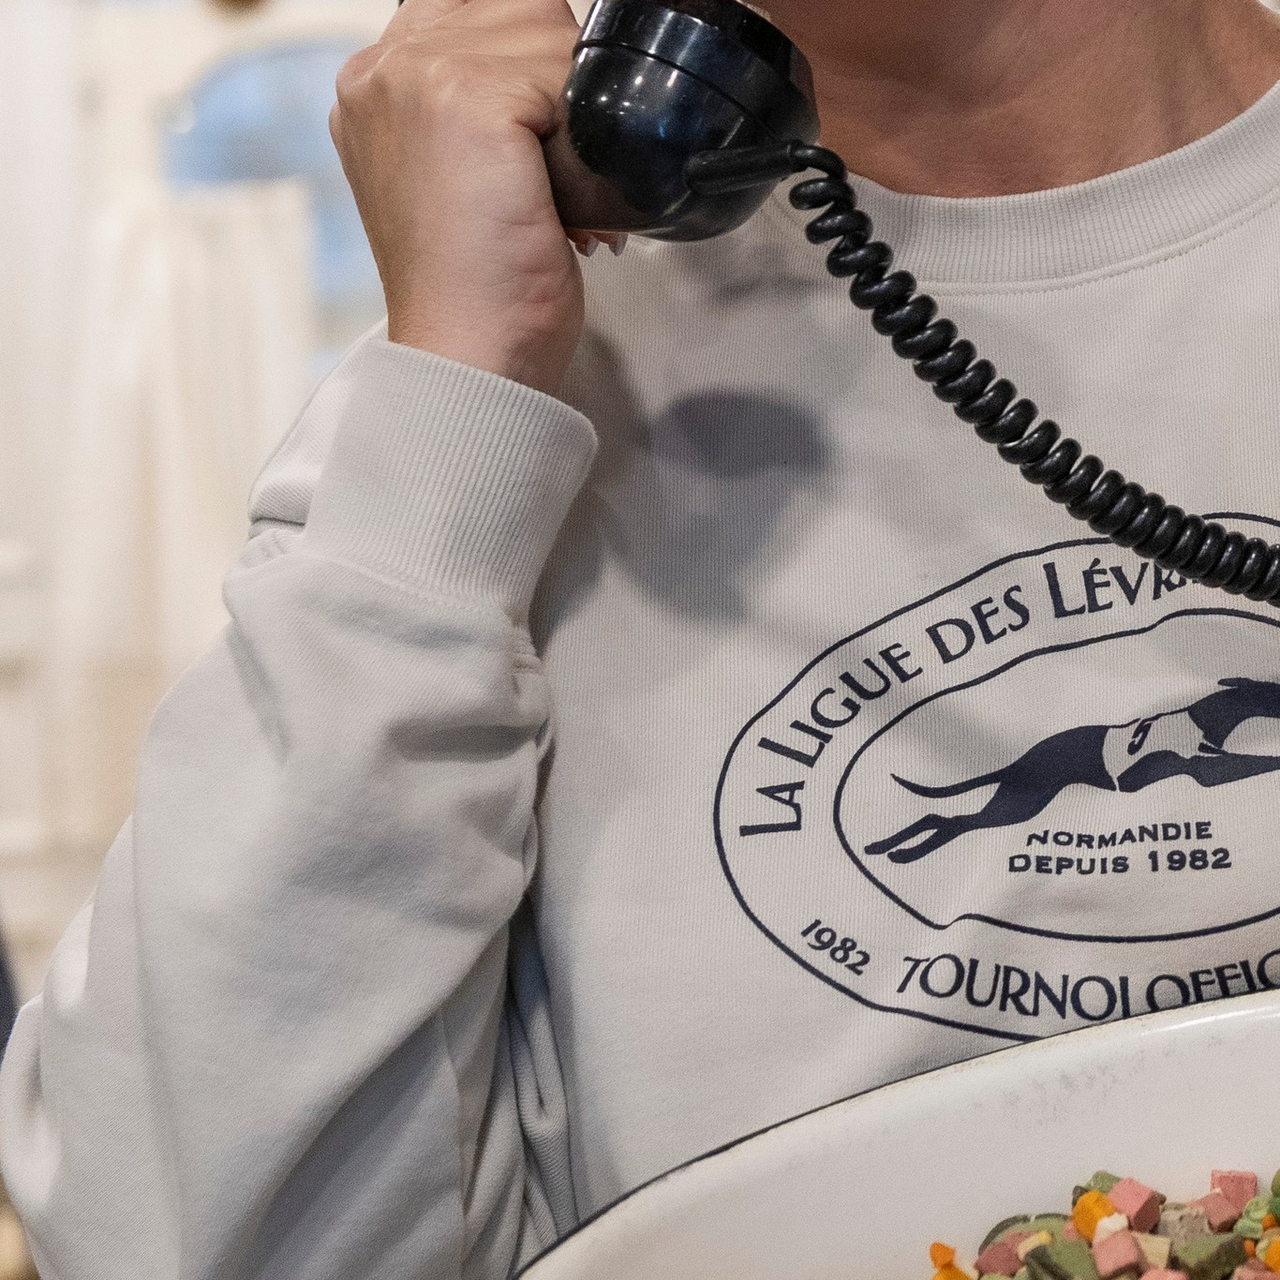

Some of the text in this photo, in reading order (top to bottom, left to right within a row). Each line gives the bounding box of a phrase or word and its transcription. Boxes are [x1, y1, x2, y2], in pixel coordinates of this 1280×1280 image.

[1042, 557, 1200, 619] LÉVR
[925, 585, 1031, 664] DES
[757, 642, 923, 768] LIGUE
[739, 780, 805, 837] LA
[1026, 821, 1213, 849] NORMANDIE
[1008, 847, 1232, 875] DEPUIS 1982
[800, 919, 871, 976] 1982
[896, 953, 1131, 1020] TOURNOI
